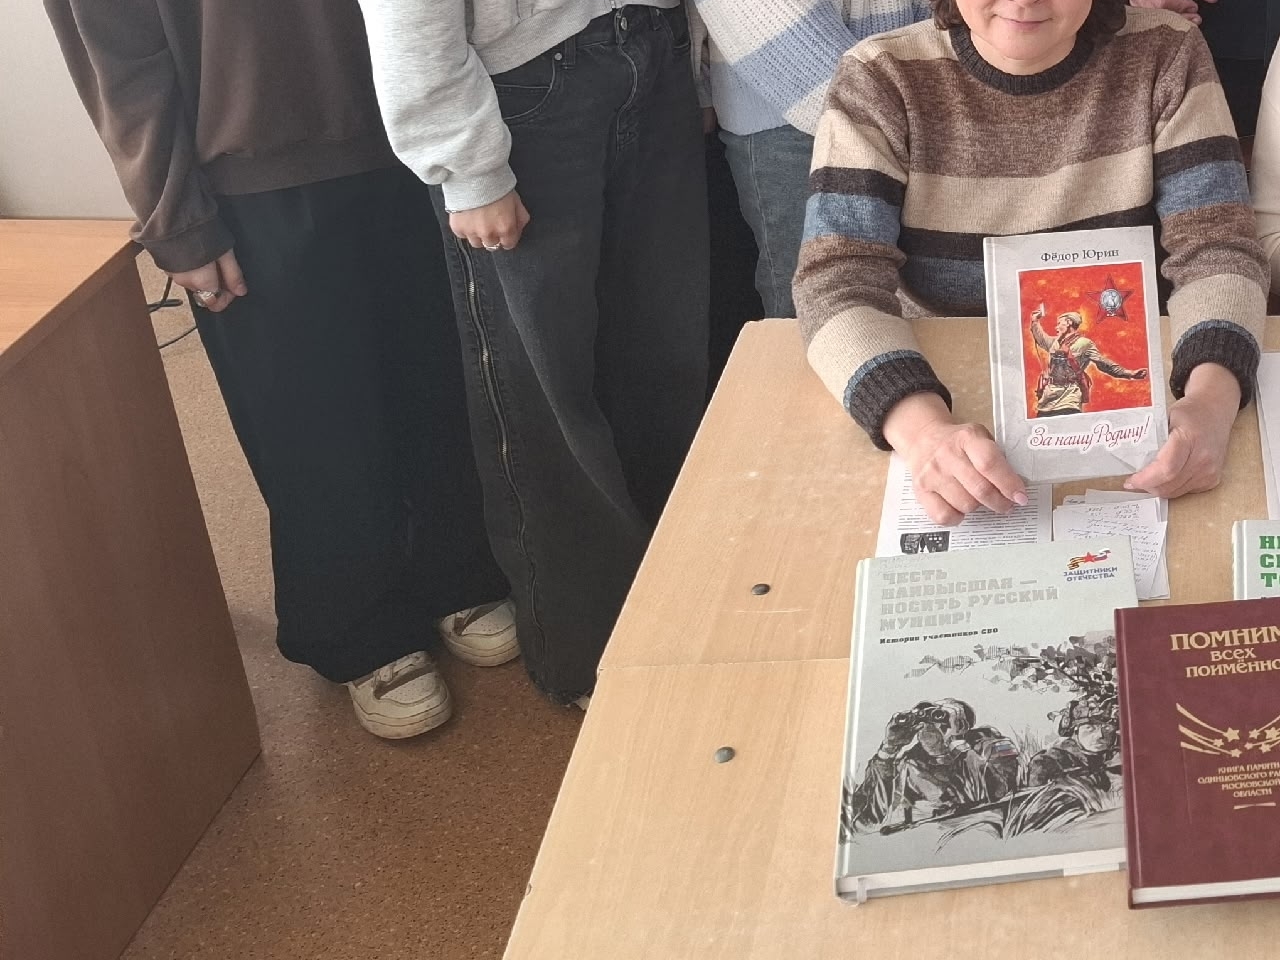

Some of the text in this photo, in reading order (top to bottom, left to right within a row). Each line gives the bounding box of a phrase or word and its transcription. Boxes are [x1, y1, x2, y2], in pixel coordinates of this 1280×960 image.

[1040, 248, 1120, 263] Фёдор Юрин
[1030, 415, 1150, 452] За нашу Родину!
[882, 568, 948, 585] ЧЕСТЬ
[1063, 566, 1118, 577] ЗАЩИТНИКИ
[1066, 573, 1115, 582] ОТЕЧЕСТВА
[881, 577, 1013, 600] НАИВЫСШАЯ
[881, 586, 1059, 615] НОСИТЬ РУССКИЙ
[879, 611, 972, 631] МУНДИР!
[879, 635, 920, 644] Истории
[923, 630, 979, 642] участников
[1218, 761, 1280, 774] КНИГА ПАМЯТИ
[1197, 771, 1268, 784] ОДИНЦОВСКОГО
[1233, 788, 1273, 798] ОБЛАСТИ
